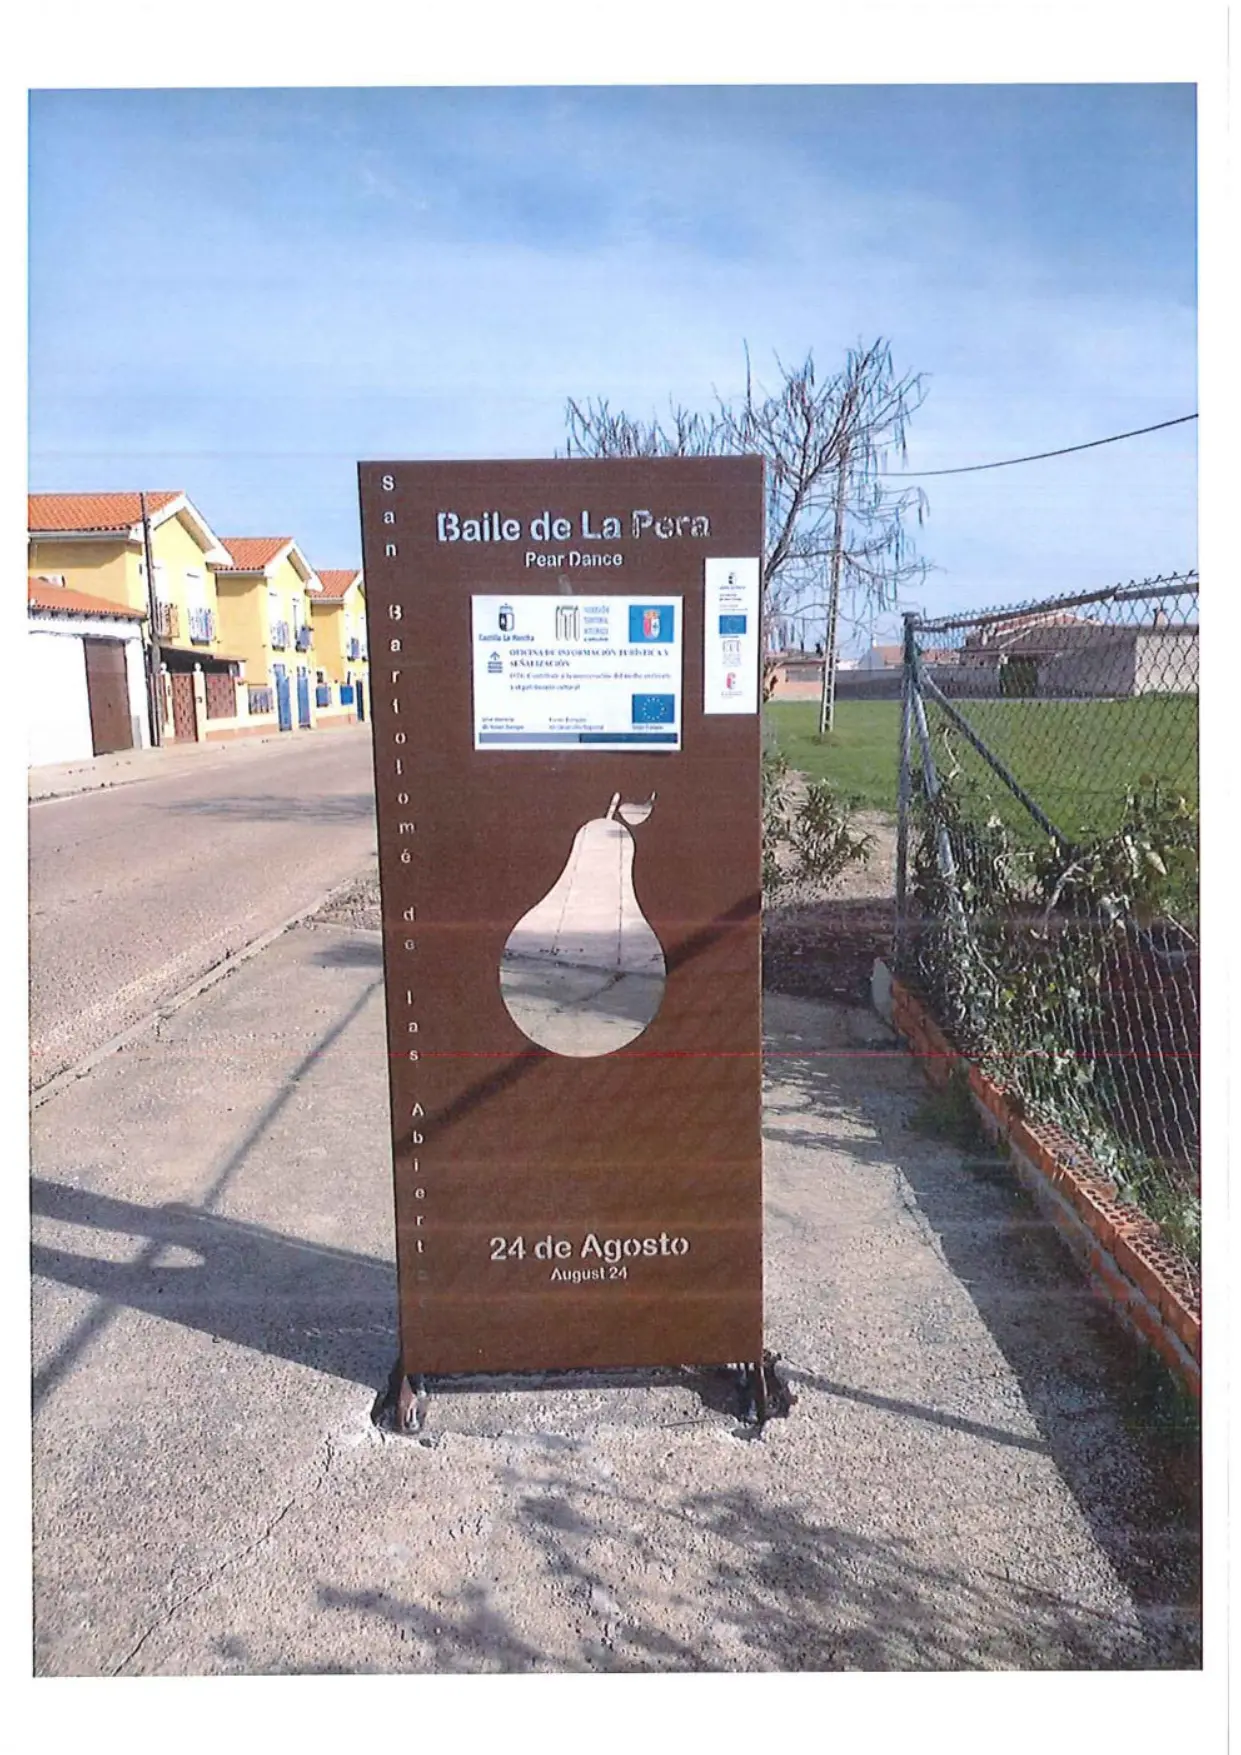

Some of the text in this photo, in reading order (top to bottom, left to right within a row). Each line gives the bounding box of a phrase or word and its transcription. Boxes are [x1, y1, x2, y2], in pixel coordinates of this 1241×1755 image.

[382, 474, 397, 557] San
[436, 509, 711, 542] Baile de La Pera
[525, 550, 623, 568] Pear Dance
[509, 648, 543, 656] OFICINA
[388, 604, 415, 864] Bartolomé
[403, 906, 415, 950] de
[407, 989, 419, 1061] las
[490, 1232, 689, 1263] 24 de Agosto
[551, 1266, 628, 1283] August 24
